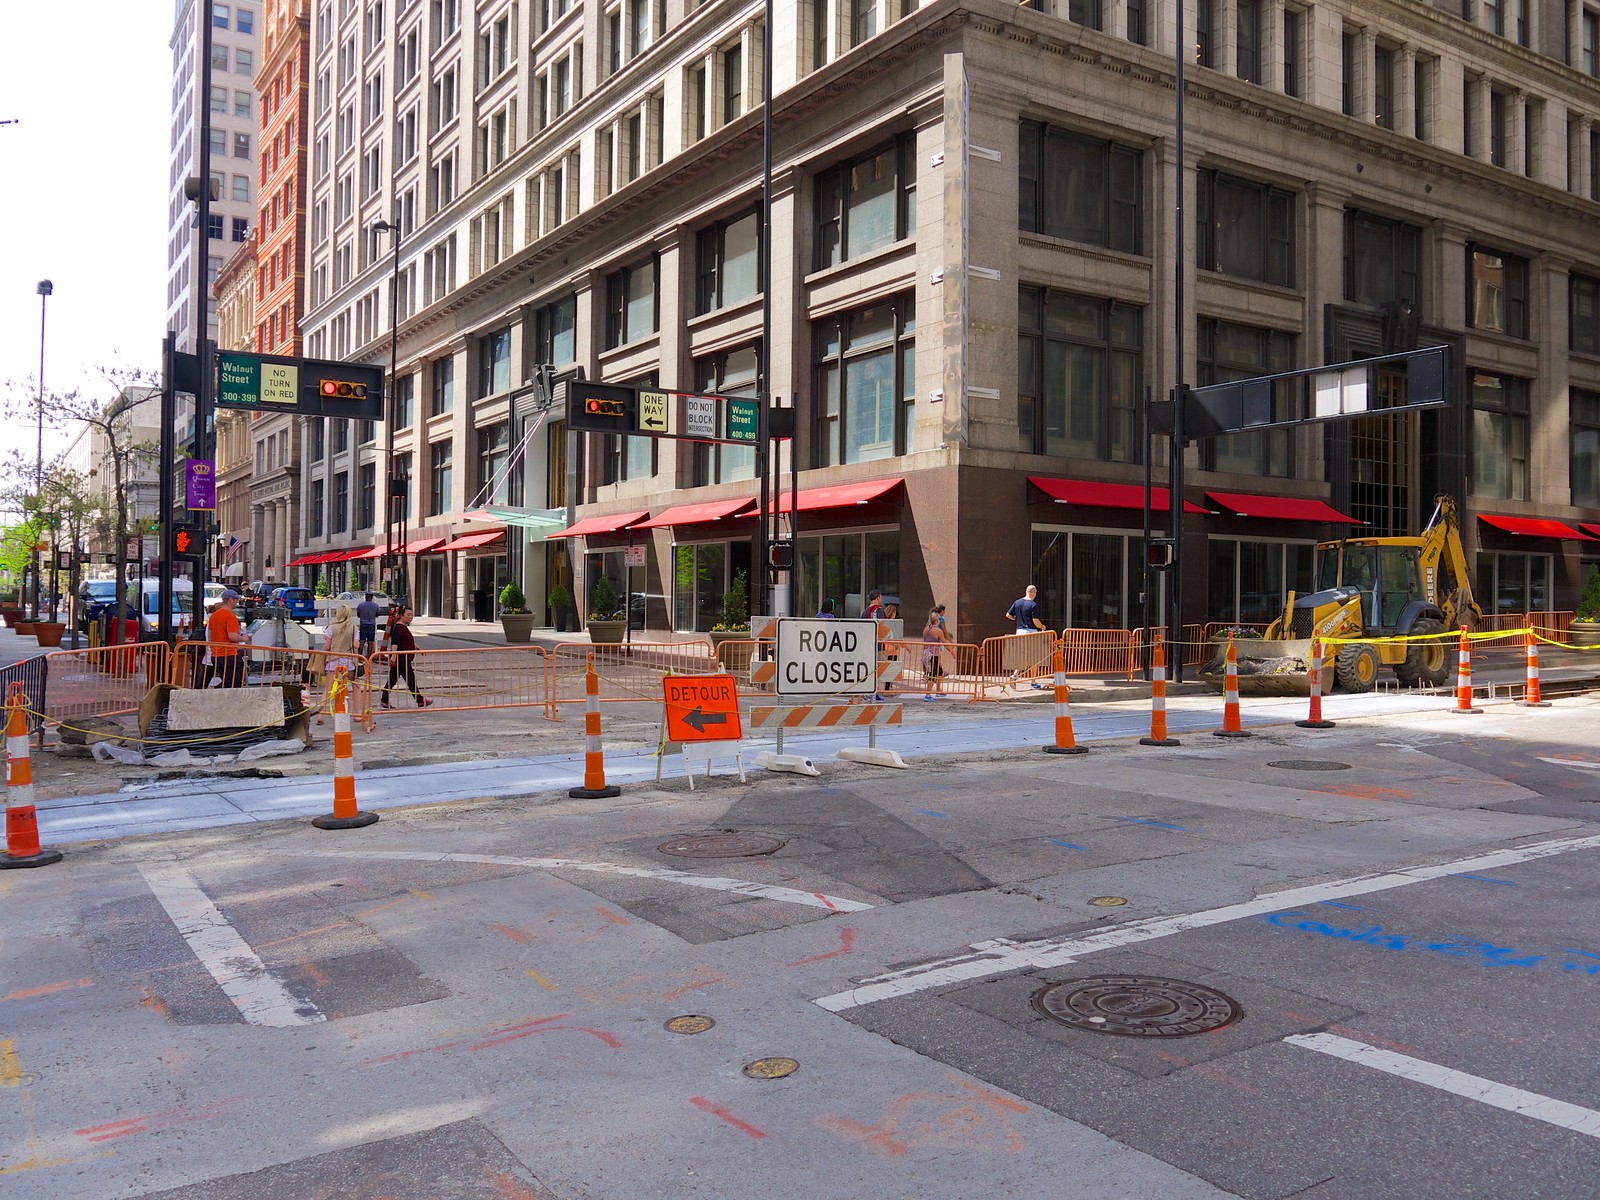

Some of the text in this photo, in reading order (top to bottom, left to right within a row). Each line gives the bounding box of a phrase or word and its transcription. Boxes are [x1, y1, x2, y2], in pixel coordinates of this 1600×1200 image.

[222, 362, 253, 374] Walnut
[221, 373, 249, 384] Street
[264, 389, 294, 399] ON RED
[644, 395, 663, 405] ONE
[643, 405, 664, 415] WAY
[688, 401, 713, 412] DO NOT
[731, 405, 753, 416] Walnut
[688, 413, 713, 424] BLOCK
[731, 414, 751, 424] Street
[688, 425, 713, 433] INTERSECTION
[1426, 567, 1435, 604] DEERE
[799, 630, 857, 652] ROAD
[786, 661, 869, 684] CLOSED
[670, 685, 730, 701] DETOUR
